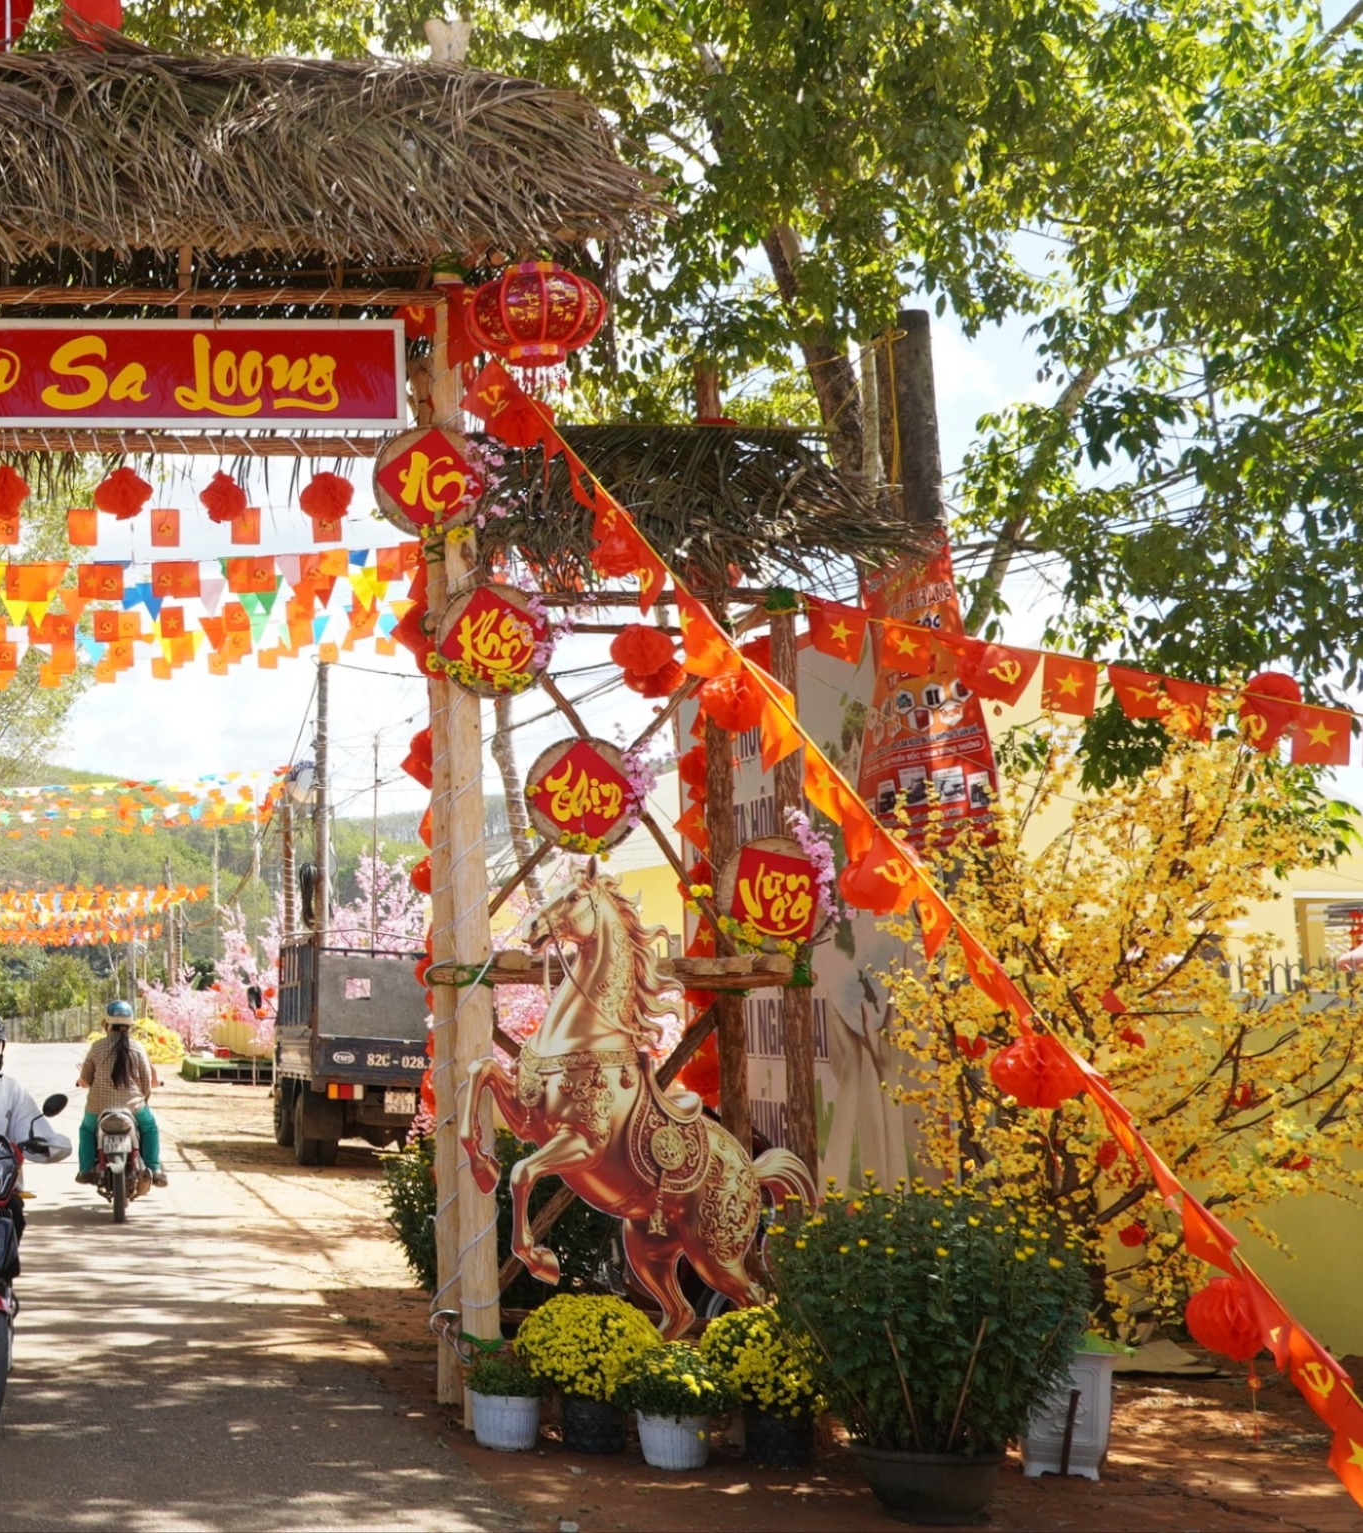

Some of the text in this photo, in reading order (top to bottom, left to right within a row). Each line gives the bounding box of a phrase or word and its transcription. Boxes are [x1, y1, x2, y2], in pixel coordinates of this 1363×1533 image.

[40, 334, 152, 411] Sa
[174, 332, 340, 417] Loong
[738, 862, 814, 937] Vượng
[367, 1054, 390, 1066] 82C
